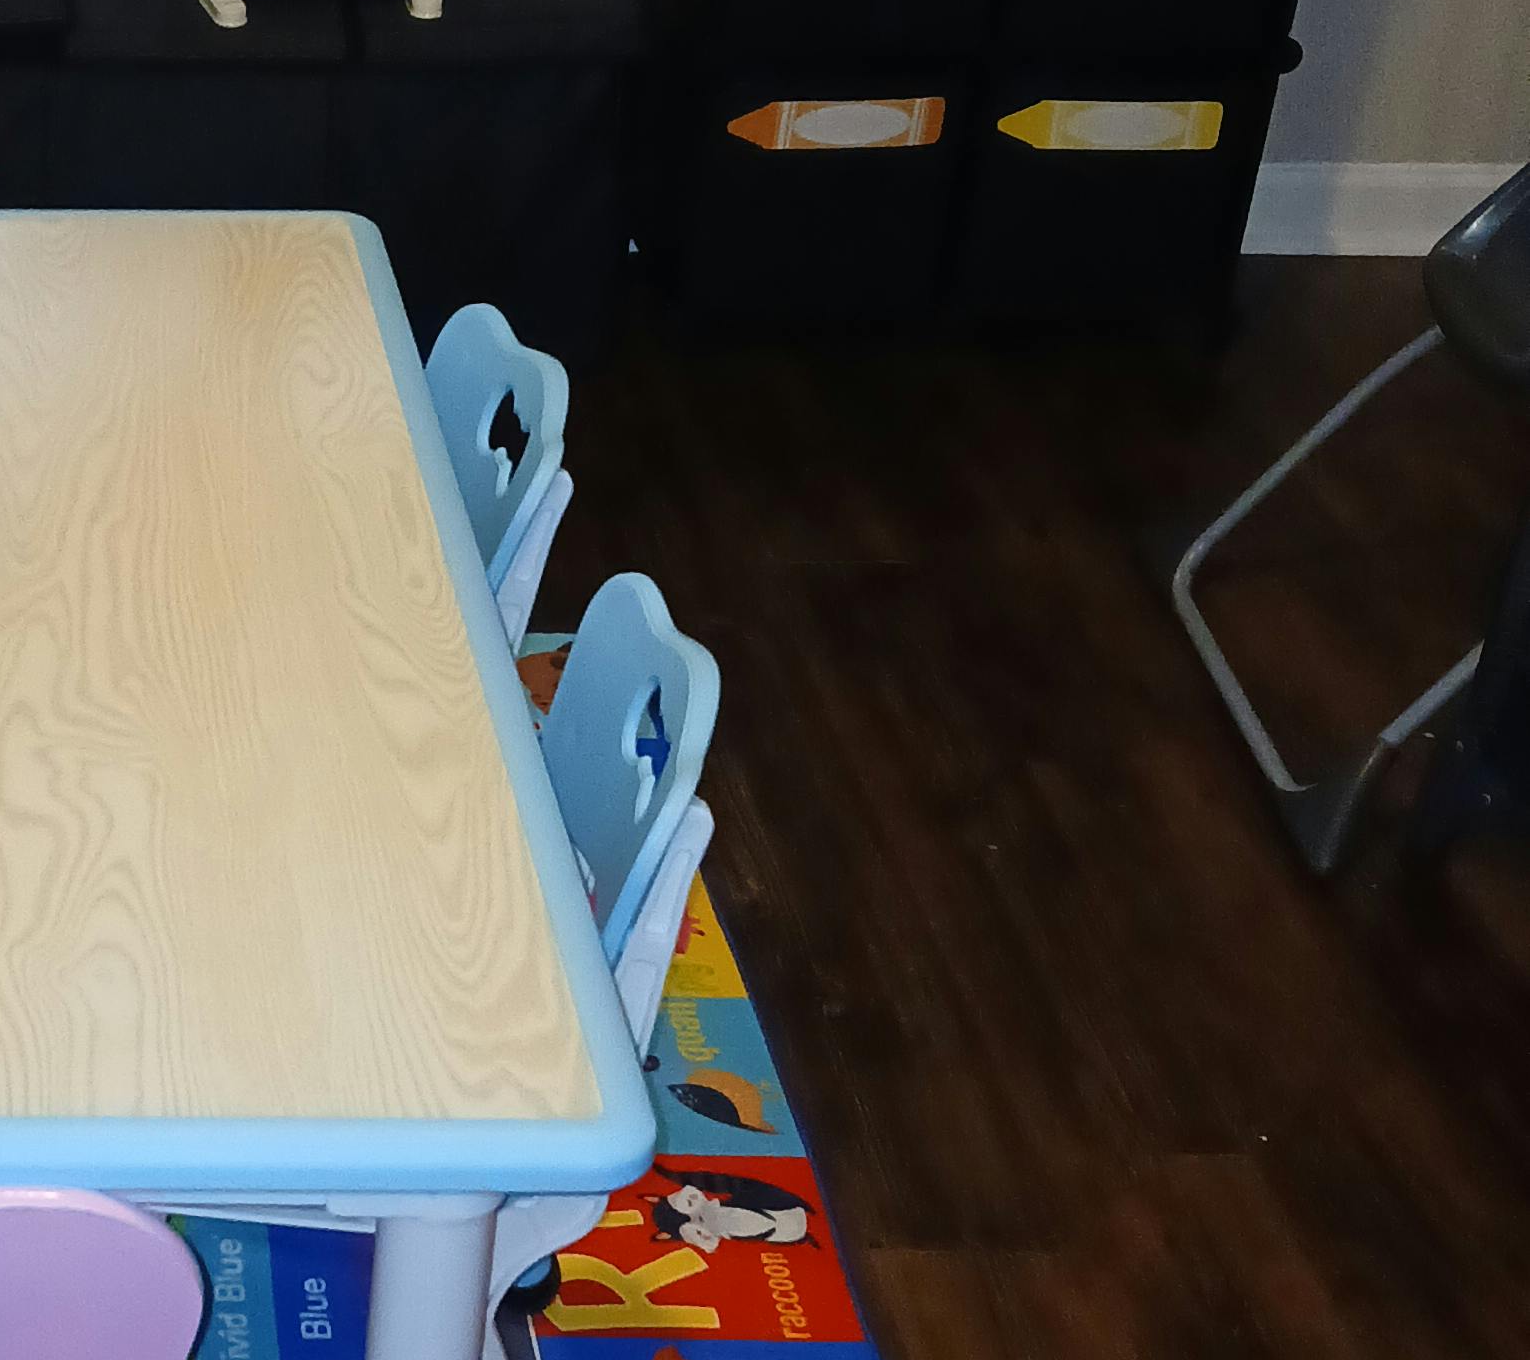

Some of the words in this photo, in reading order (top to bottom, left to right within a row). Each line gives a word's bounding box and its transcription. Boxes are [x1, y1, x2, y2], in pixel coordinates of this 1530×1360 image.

[214, 1238, 246, 1303] Blue
[759, 1251, 812, 1340] raccoon
[300, 1277, 332, 1339] Blue
